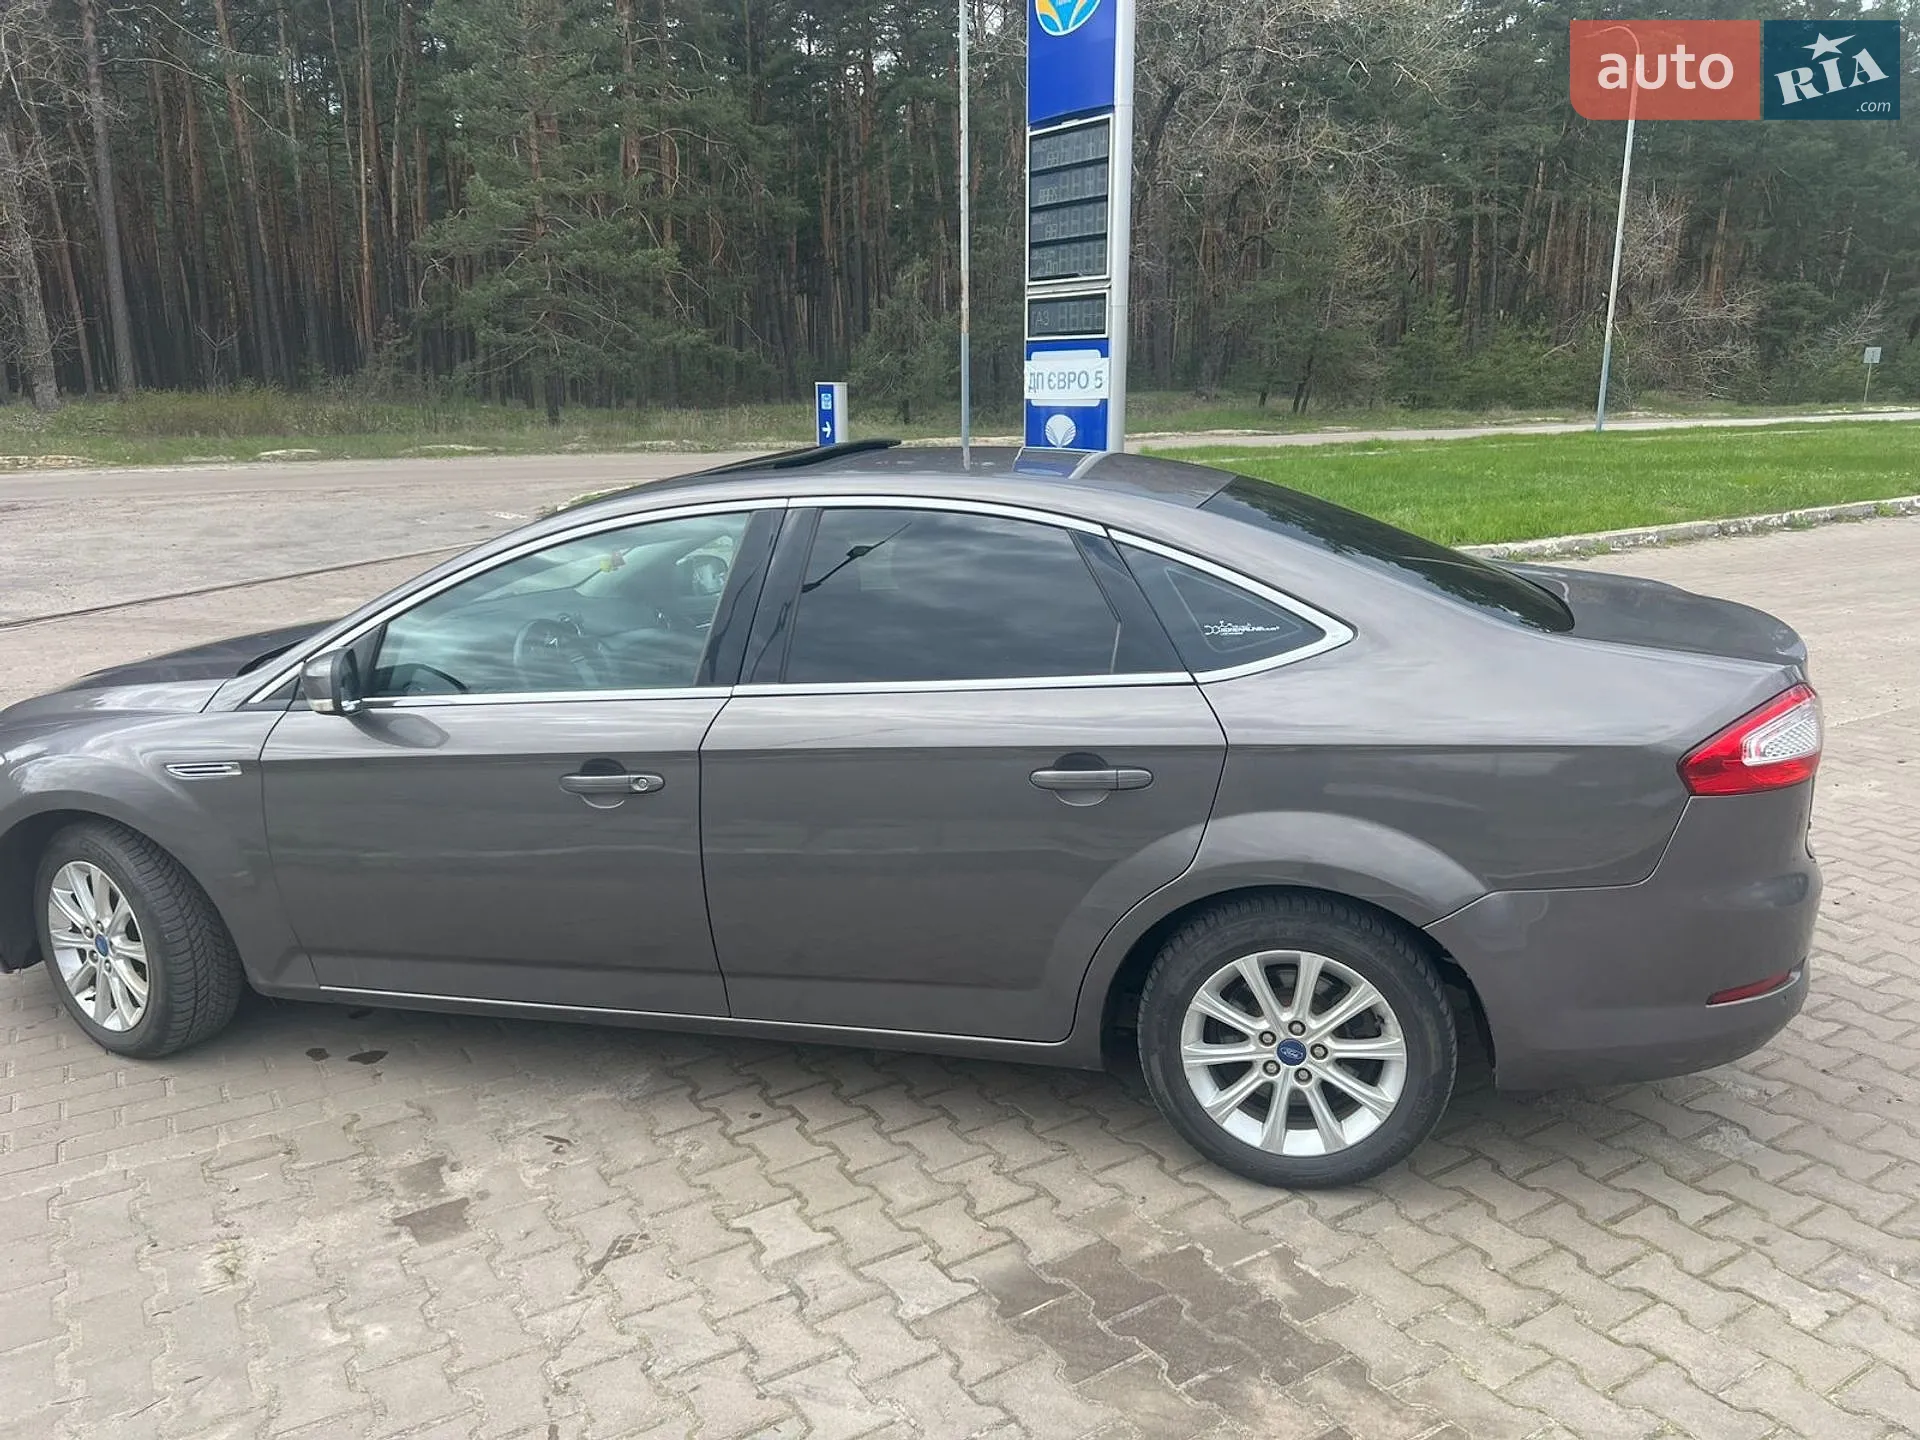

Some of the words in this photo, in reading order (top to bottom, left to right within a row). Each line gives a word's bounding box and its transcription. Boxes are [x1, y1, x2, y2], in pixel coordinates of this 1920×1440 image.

[1028, 371, 1044, 393] ДП
[1047, 370, 1089, 390] ЄВРО
[1094, 370, 1104, 389] 5
